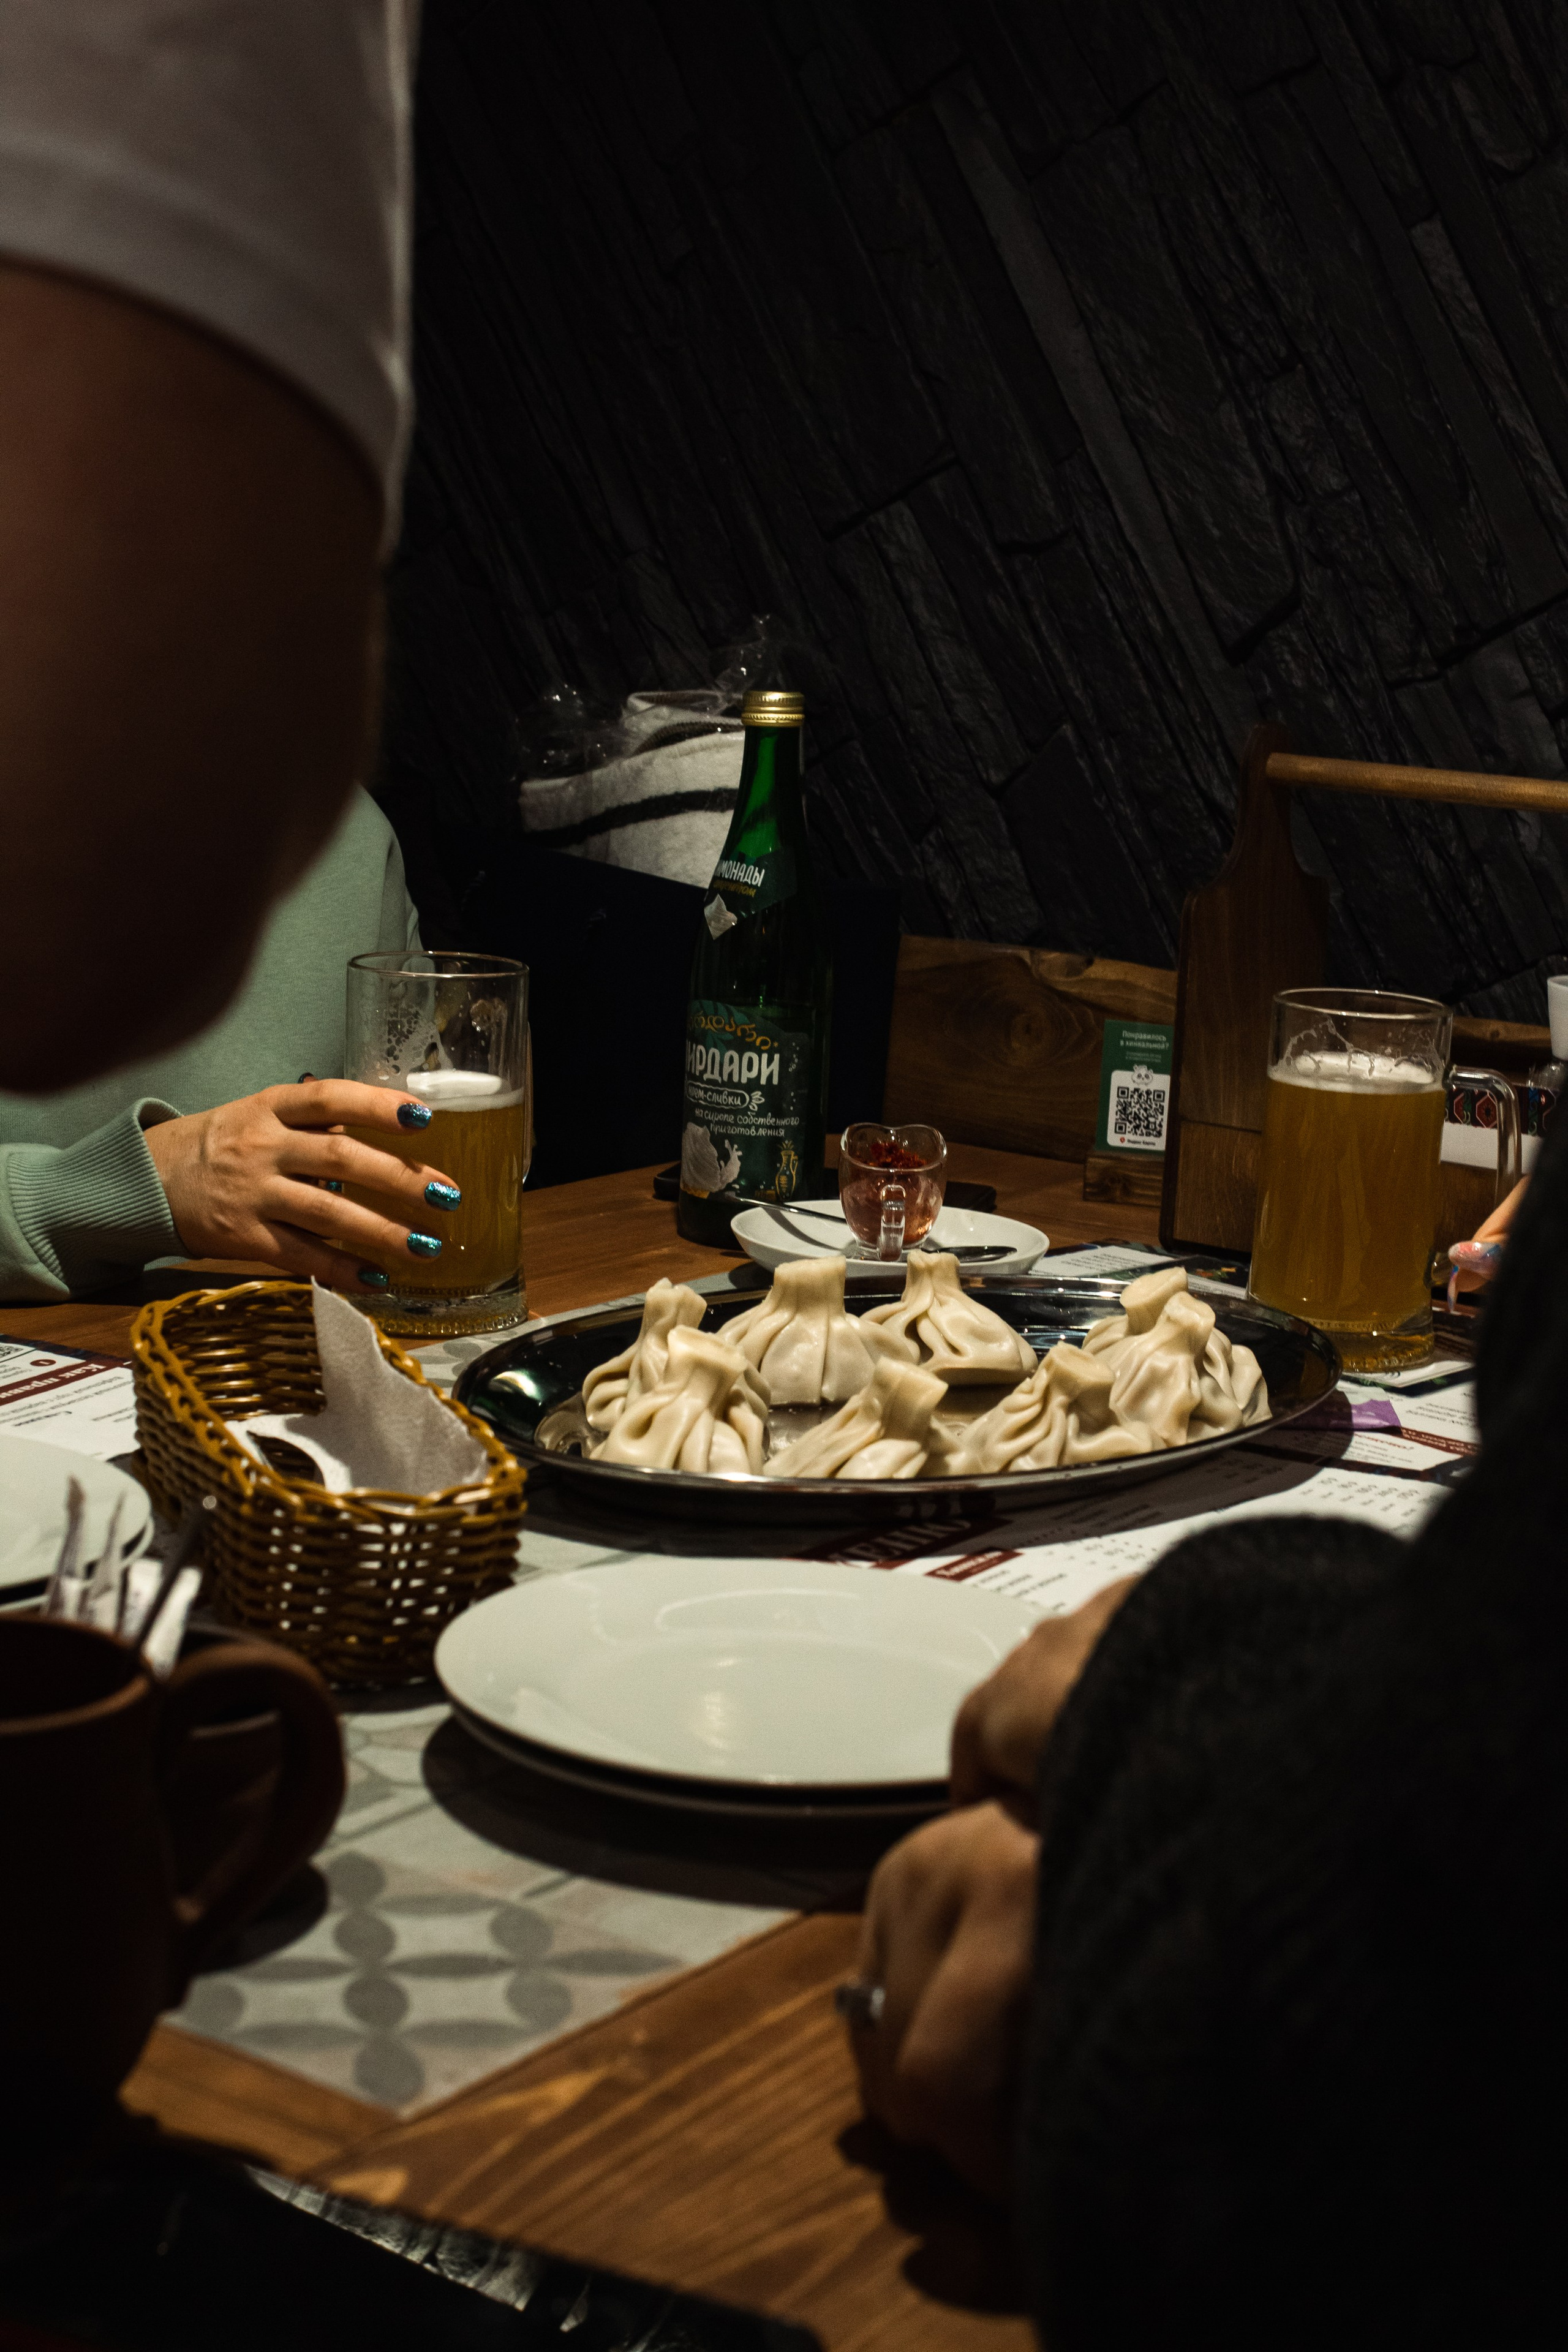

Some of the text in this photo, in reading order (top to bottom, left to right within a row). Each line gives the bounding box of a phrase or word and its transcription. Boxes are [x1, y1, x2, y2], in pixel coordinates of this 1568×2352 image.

[714, 859, 765, 887] МОНАДЫ
[1122, 1030, 1167, 1042] Понравилось
[1126, 1040, 1169, 1050] хинкальной?
[686, 1039, 780, 1085] ИРДАРИ
[688, 1085, 742, 1106] крем-сливки
[695, 1108, 800, 1126] на сиропе собственного
[710, 1123, 785, 1137] приготовления
[58, 1363, 107, 1379] Как
